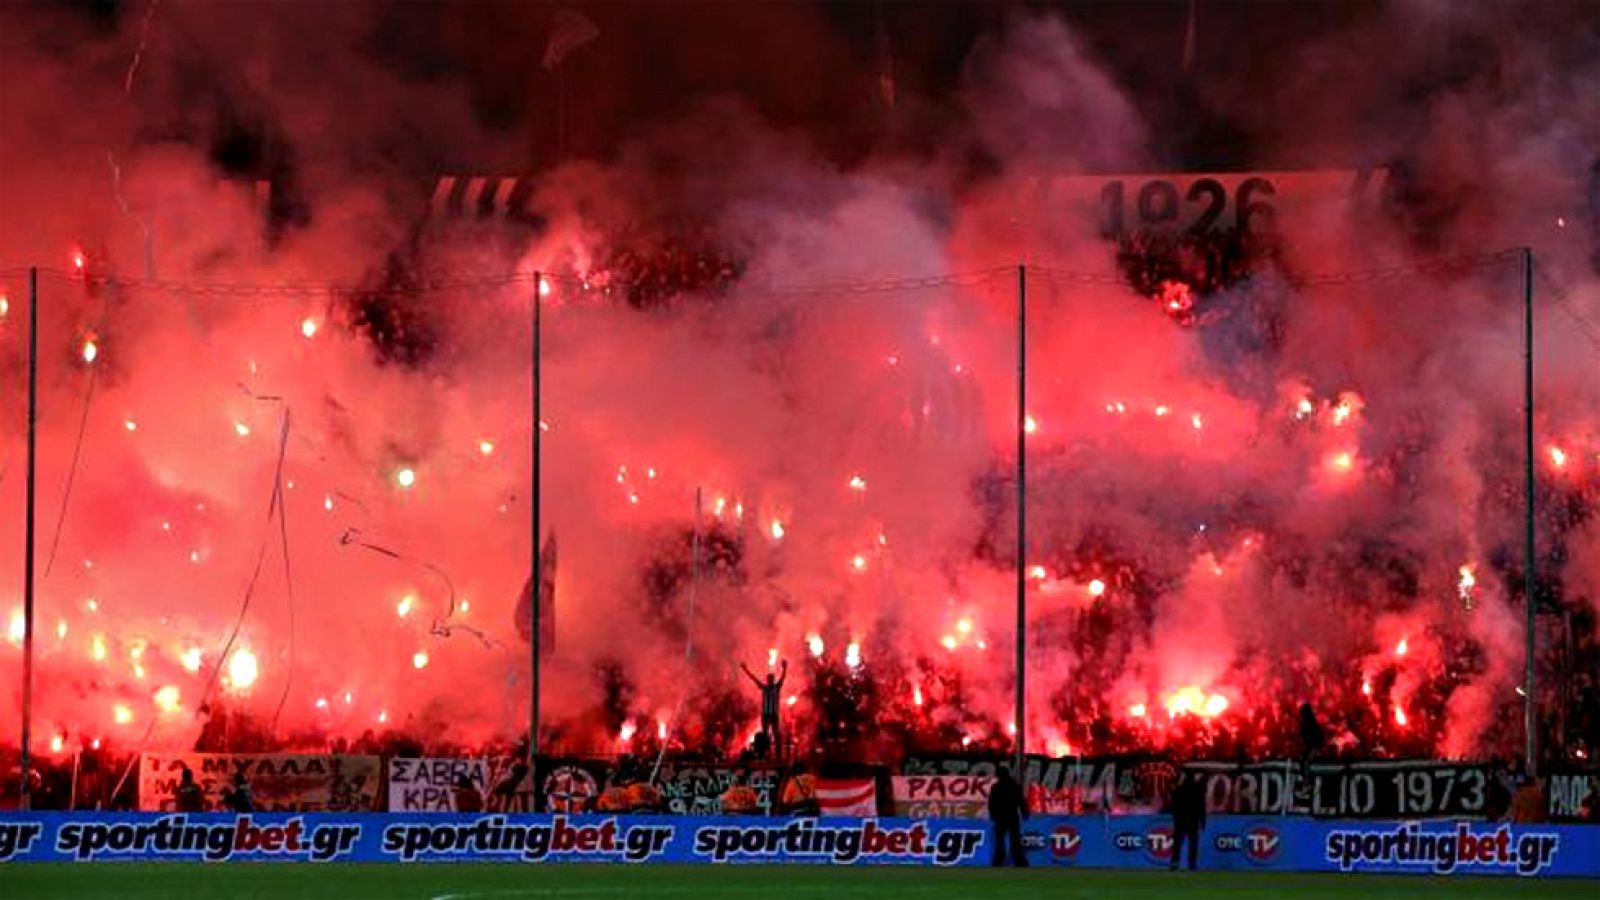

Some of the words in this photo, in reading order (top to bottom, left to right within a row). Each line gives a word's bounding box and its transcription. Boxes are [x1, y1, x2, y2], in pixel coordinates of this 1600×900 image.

[1096, 177, 1277, 238] 1926
[908, 777, 988, 798] PAOK
[1392, 769, 1486, 815] 1973
[57, 814, 361, 860] sportingbet.gr
[382, 815, 673, 862] sportingbet.gr
[695, 818, 985, 864] sportingbet.gr
[1326, 821, 1559, 876] sportingbet.gr
